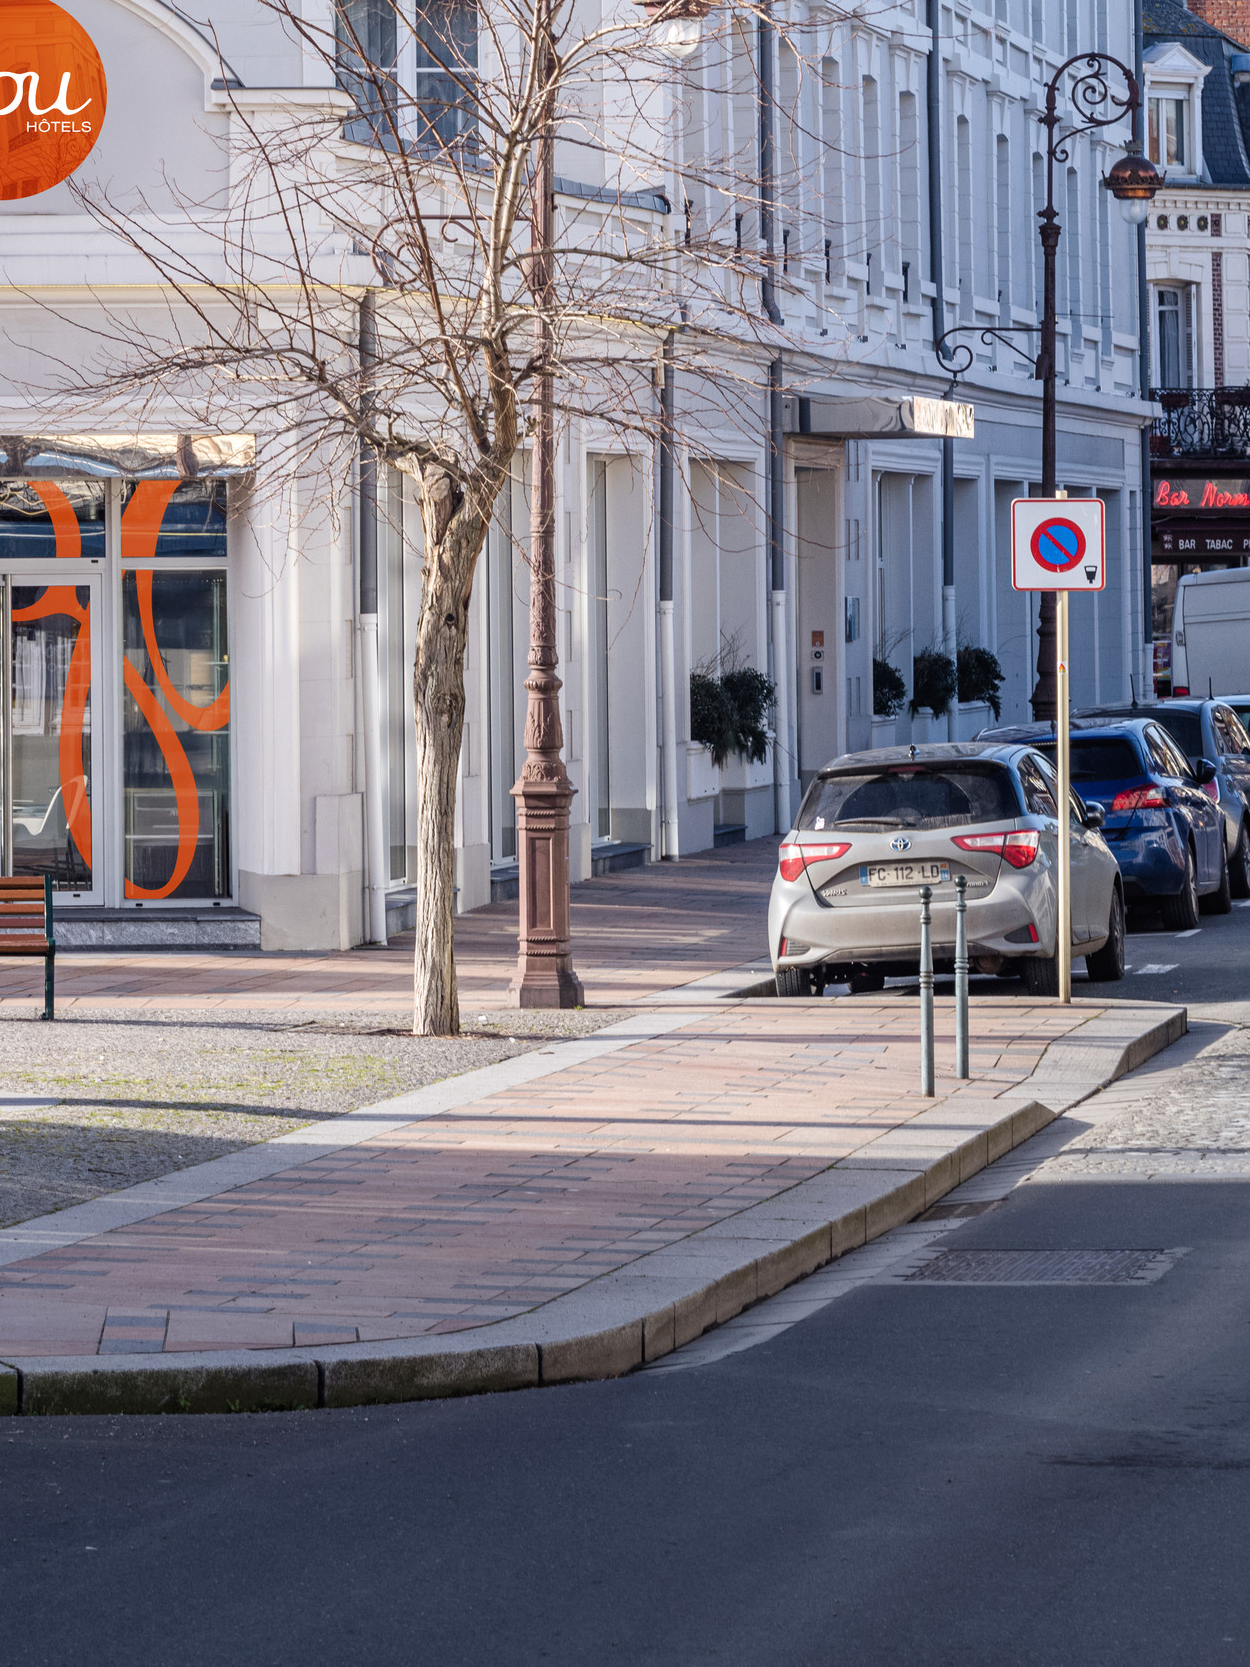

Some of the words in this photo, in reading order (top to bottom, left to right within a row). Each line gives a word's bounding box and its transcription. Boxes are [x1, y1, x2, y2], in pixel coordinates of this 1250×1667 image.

[26, 118, 92, 133] HÔTELS
[1157, 480, 1190, 506] Bar
[1178, 539, 1196, 550] BAR
[1205, 539, 1233, 550] TABAC
